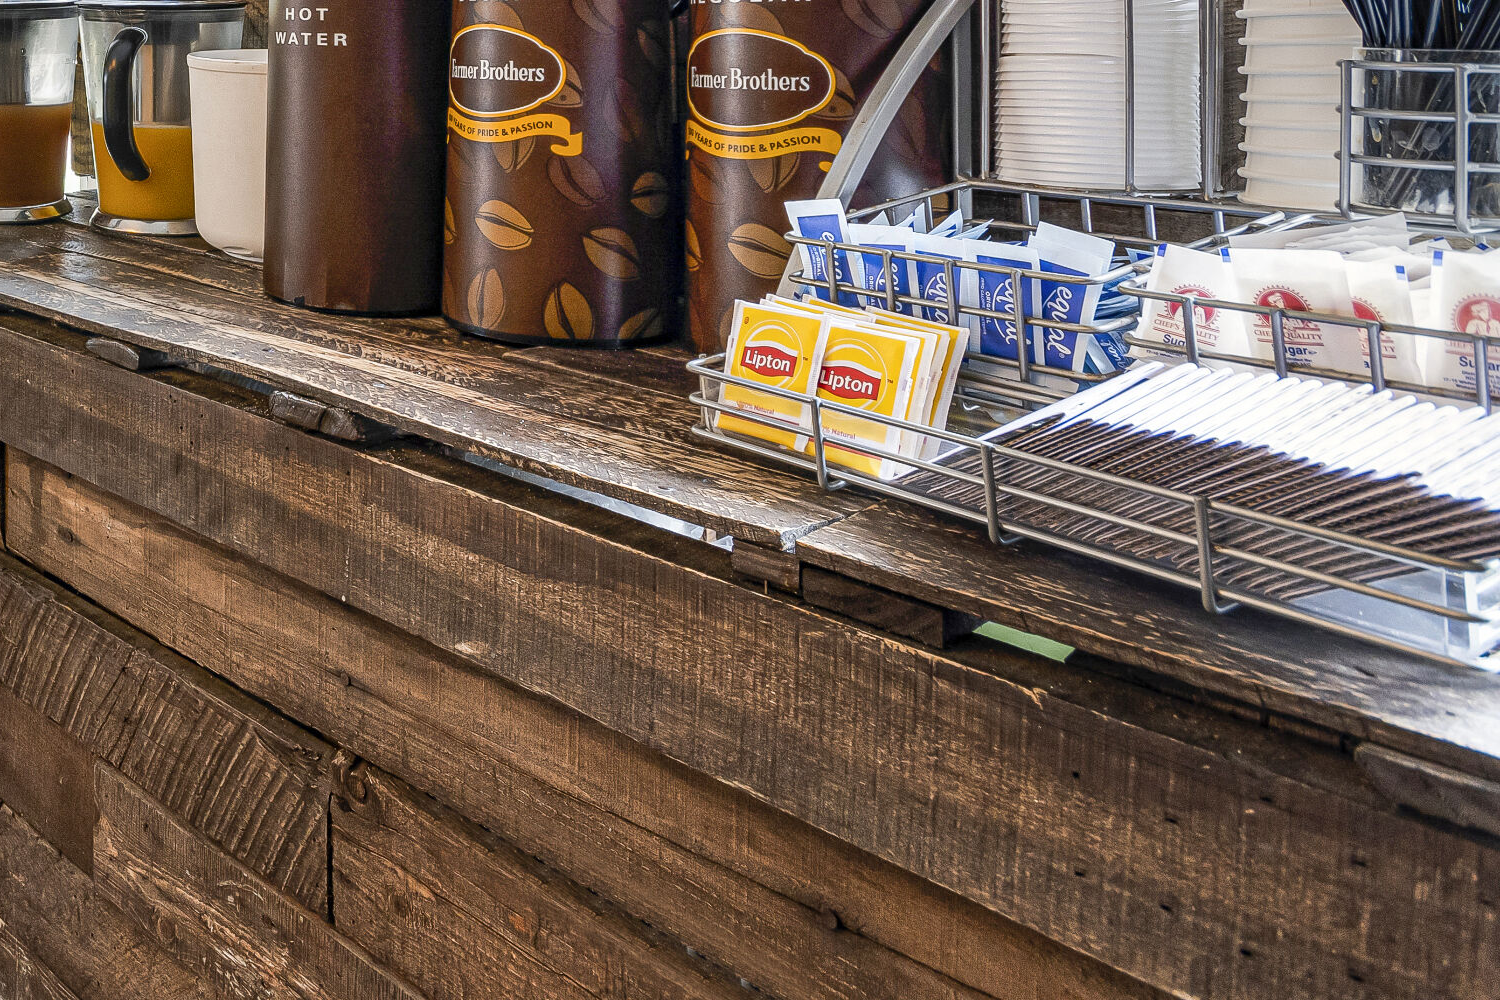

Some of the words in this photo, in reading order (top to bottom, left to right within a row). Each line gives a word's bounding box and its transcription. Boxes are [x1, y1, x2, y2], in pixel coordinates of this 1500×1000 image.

[285, 7, 329, 21] HOT
[275, 32, 348, 46] WATER
[452, 58, 478, 80] Farmer
[480, 60, 545, 82] Brothers
[691, 66, 727, 89] Farmer
[730, 68, 810, 92] Brothers
[467, 126, 476, 134] OF
[478, 128, 500, 136] PRIDE
[510, 120, 552, 135] PASSION
[694, 131, 712, 148] YEARS
[714, 142, 726, 150] OF
[728, 144, 756, 153] PRIDE
[758, 144, 768, 152] &
[770, 135, 821, 151] PASSION
[745, 348, 791, 372] Lipton
[820, 369, 874, 395] Lipton
[754, 404, 775, 414] Natural
[832, 428, 856, 440] Natural
